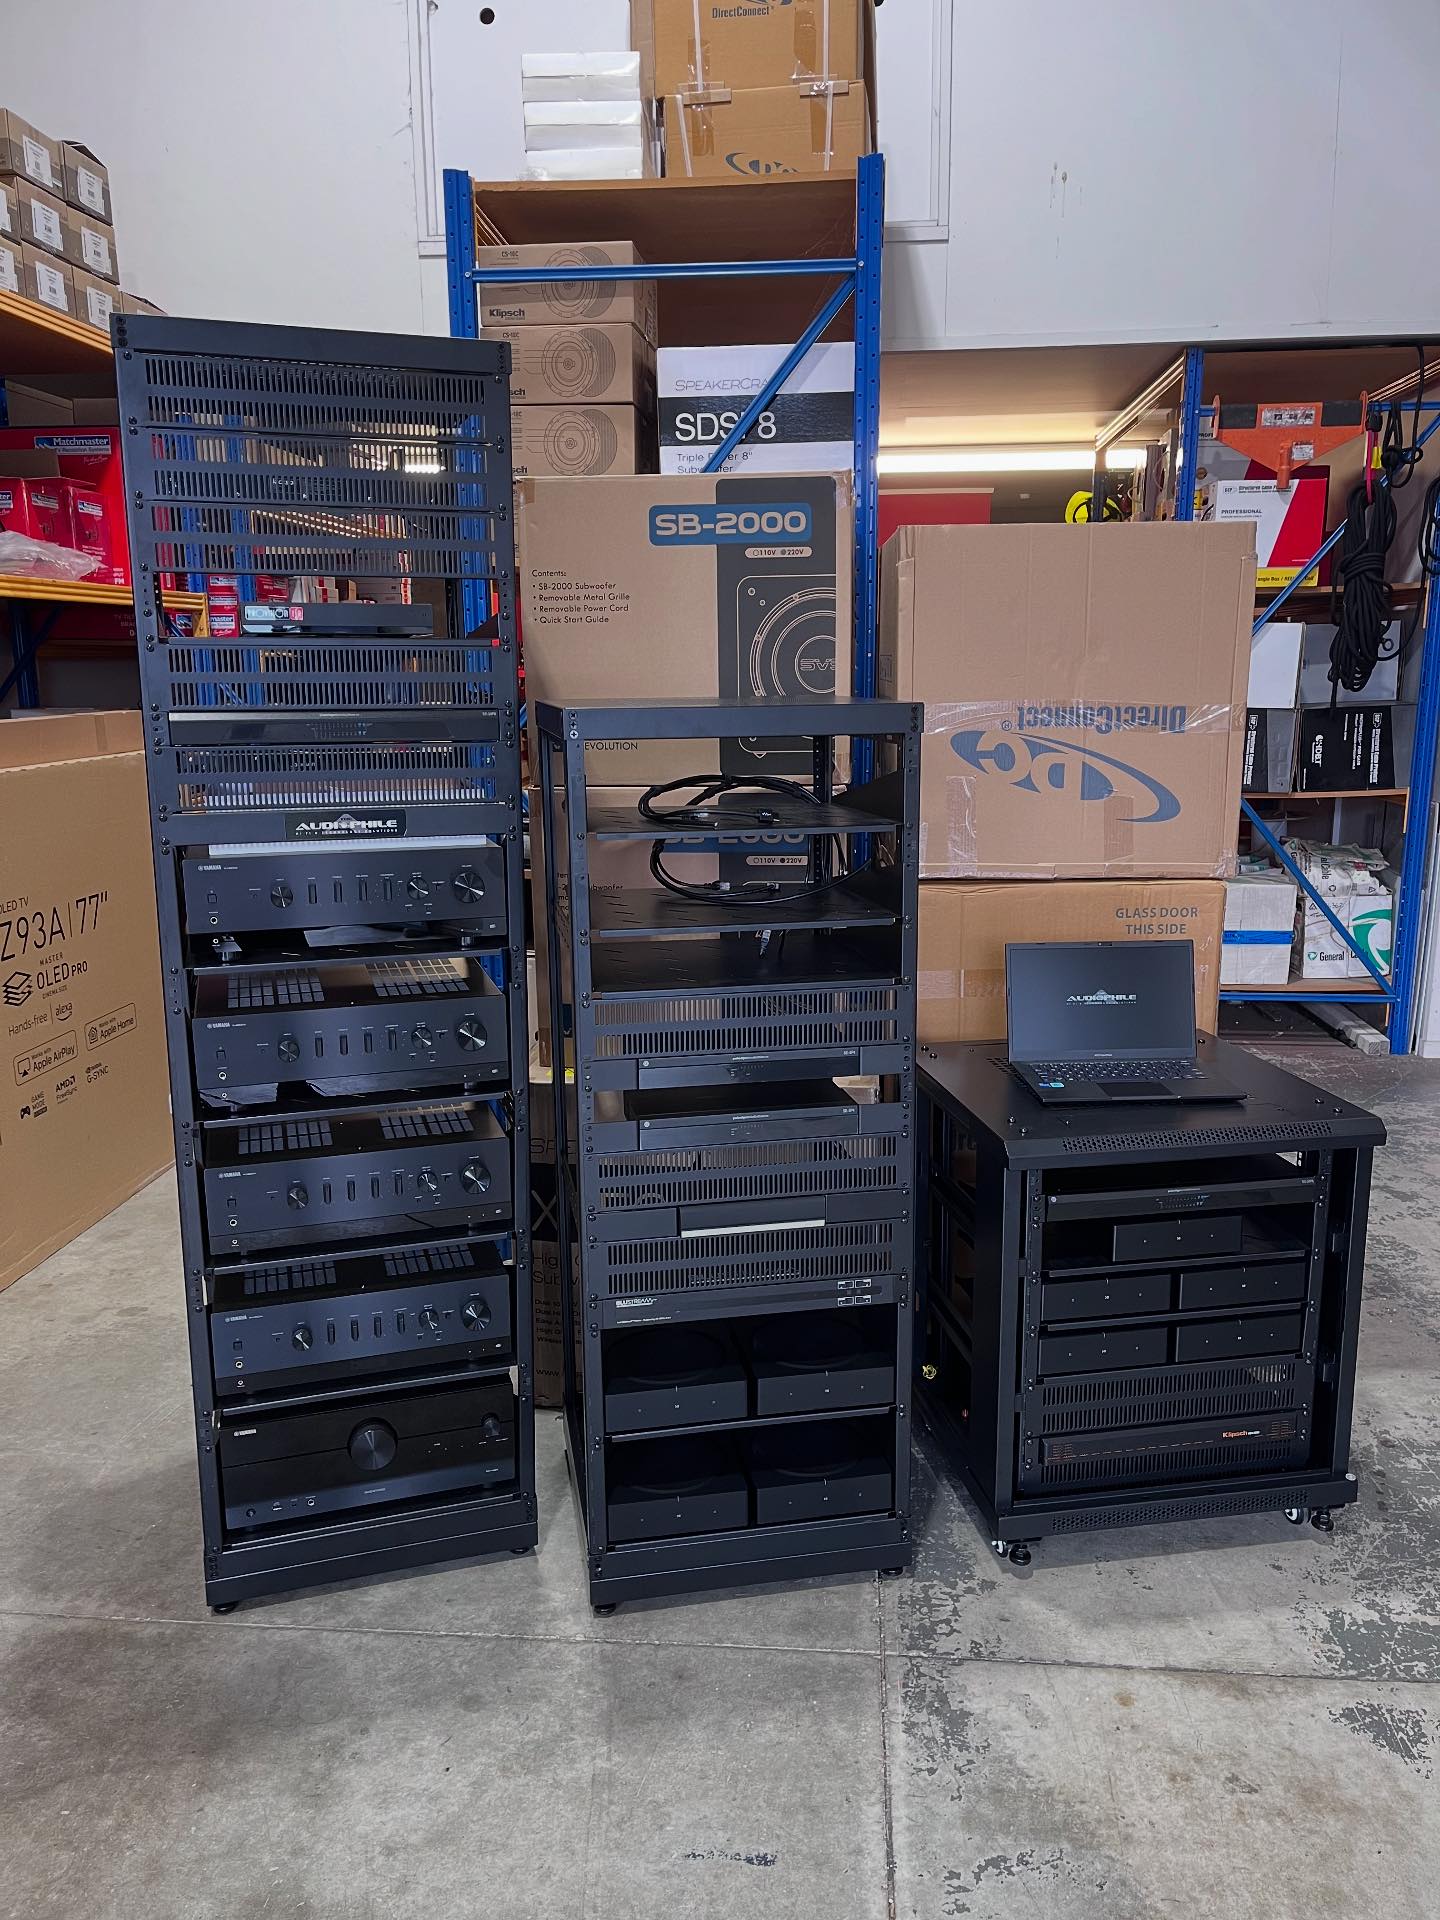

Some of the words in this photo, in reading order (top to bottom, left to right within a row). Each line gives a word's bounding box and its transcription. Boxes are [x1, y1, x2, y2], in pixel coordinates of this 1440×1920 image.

[712, 6, 770, 18] DirectConnect
[489, 308, 525, 319] Klipsch
[53, 437, 109, 446] Matchmaster
[677, 453, 705, 462] Triple
[741, 451, 753, 460] 8"
[655, 511, 807, 536] SB-2000
[531, 569, 567, 577] Contents:
[538, 583, 573, 591] SB-2000
[575, 582, 617, 590] Subwoofer
[539, 594, 581, 602] Removable
[583, 593, 606, 601] Metal
[608, 593, 631, 601] Grille
[539, 605, 582, 613] Removable
[584, 604, 607, 612] Power
[609, 604, 629, 612] Cord
[539, 616, 562, 624] Quick
[564, 615, 583, 624] Start
[585, 615, 609, 623] Guide
[584, 742, 638, 751] EVOLUTION
[295, 819, 398, 831] AUDIOPHILE
[19, 895, 29, 908] TV
[1115, 907, 1157, 918] GLASS
[1159, 907, 1198, 918] DOOR
[0, 906, 65, 961] Z93A
[76, 890, 108, 934] 77"
[1126, 923, 1155, 935] THIS
[1157, 923, 1187, 935] SIDE
[39, 951, 64, 966] MASTER
[1319, 951, 1345, 961] General
[36, 962, 70, 989] OLED
[71, 960, 88, 976] PRO
[8, 1012, 48, 1037] Hands-free
[55, 1002, 73, 1016] alexa
[99, 1024, 117, 1040] Apple
[117, 1017, 134, 1031] Home
[32, 1056, 52, 1072] Apple
[53, 1045, 75, 1062] AirPlay
[86, 1065, 109, 1084] G-SYNC
[1222, 1430, 1248, 1438] Klipsch
